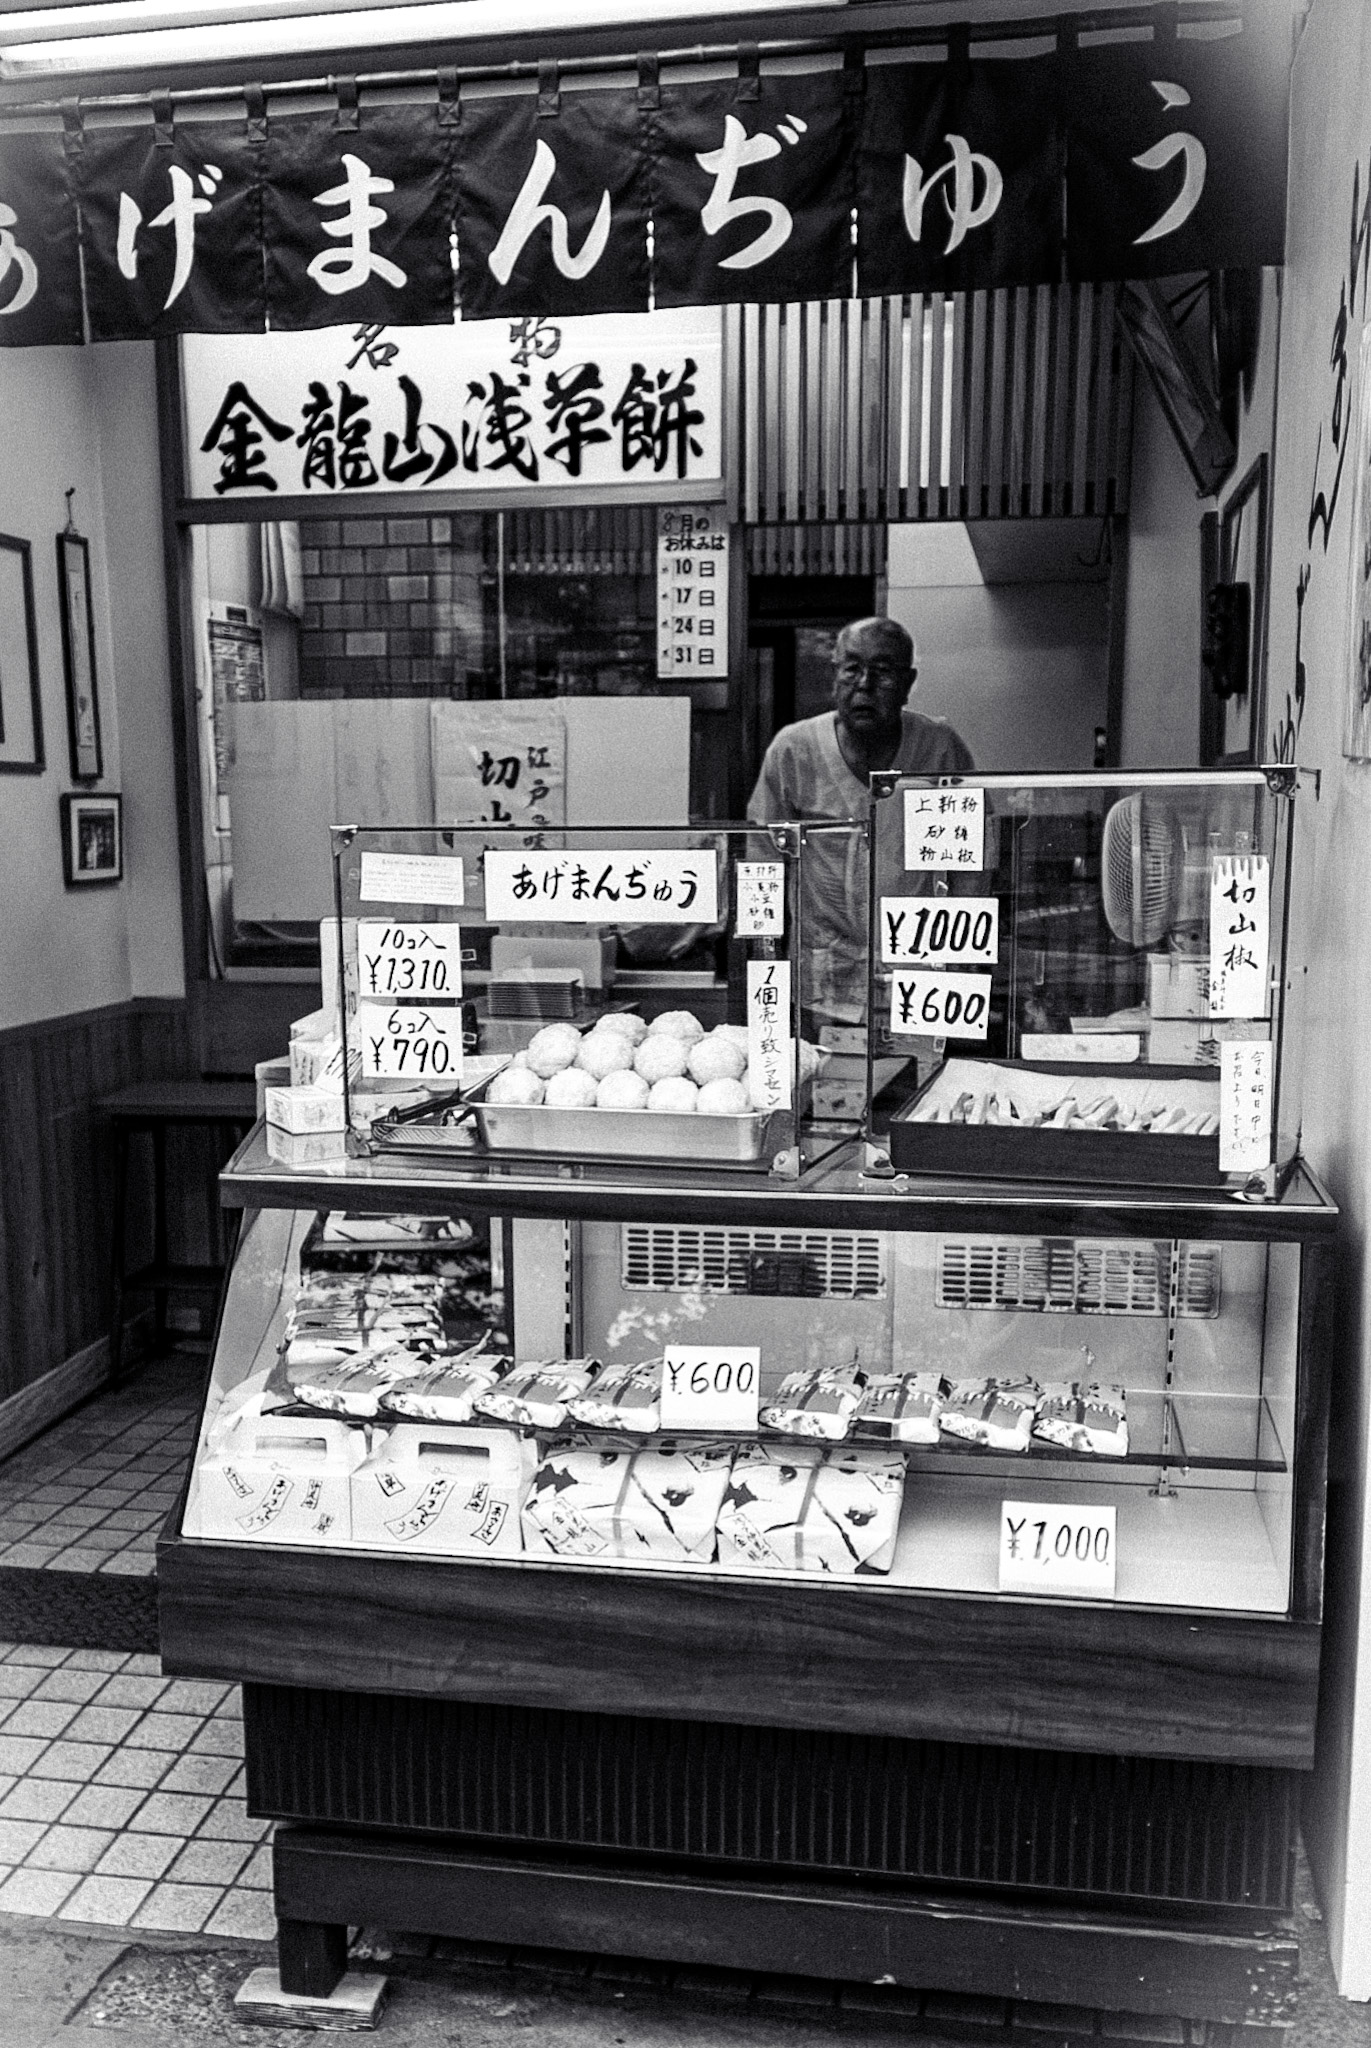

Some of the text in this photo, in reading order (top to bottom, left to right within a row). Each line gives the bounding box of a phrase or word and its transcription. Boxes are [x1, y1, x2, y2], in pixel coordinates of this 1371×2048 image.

[663, 512, 710, 533] 8月の
[665, 534, 726, 552] お休みは
[675, 558, 715, 578] 10日
[676, 588, 715, 607] 17日
[675, 618, 715, 636] 24日
[675, 647, 715, 665] 31日
[512, 860, 698, 909] あげまんぢゅう
[1222, 879, 1259, 972] 切山椒
